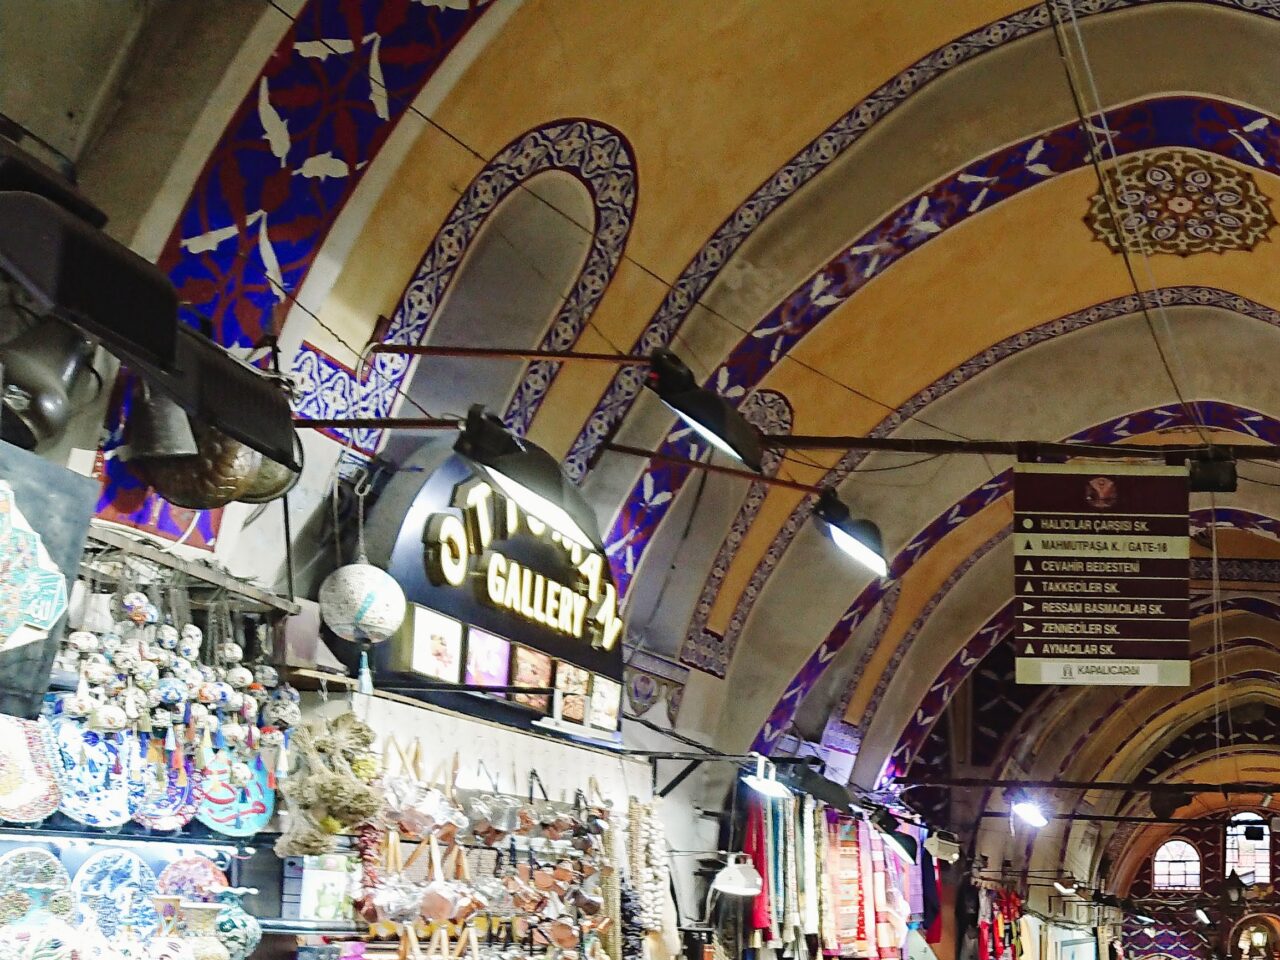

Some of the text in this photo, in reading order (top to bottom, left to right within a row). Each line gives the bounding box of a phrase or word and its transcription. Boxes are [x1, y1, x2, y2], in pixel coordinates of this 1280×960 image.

[1041, 519, 1092, 530] HALICILAR
[1094, 520, 1132, 533] ÇARŞISI
[1042, 540, 1108, 553] MAHMUTPAŞA
[440, 481, 623, 652] OTAN
[1041, 559, 1140, 573] CEVAHİR BEDESTENİ
[1042, 580, 1102, 592] TAKKECİLER
[487, 552, 588, 638] GALLERY
[1042, 602, 1083, 613] RESSAM
[1085, 603, 1146, 614] BASMACILAR
[1042, 643, 1097, 654] AYNACILAR
